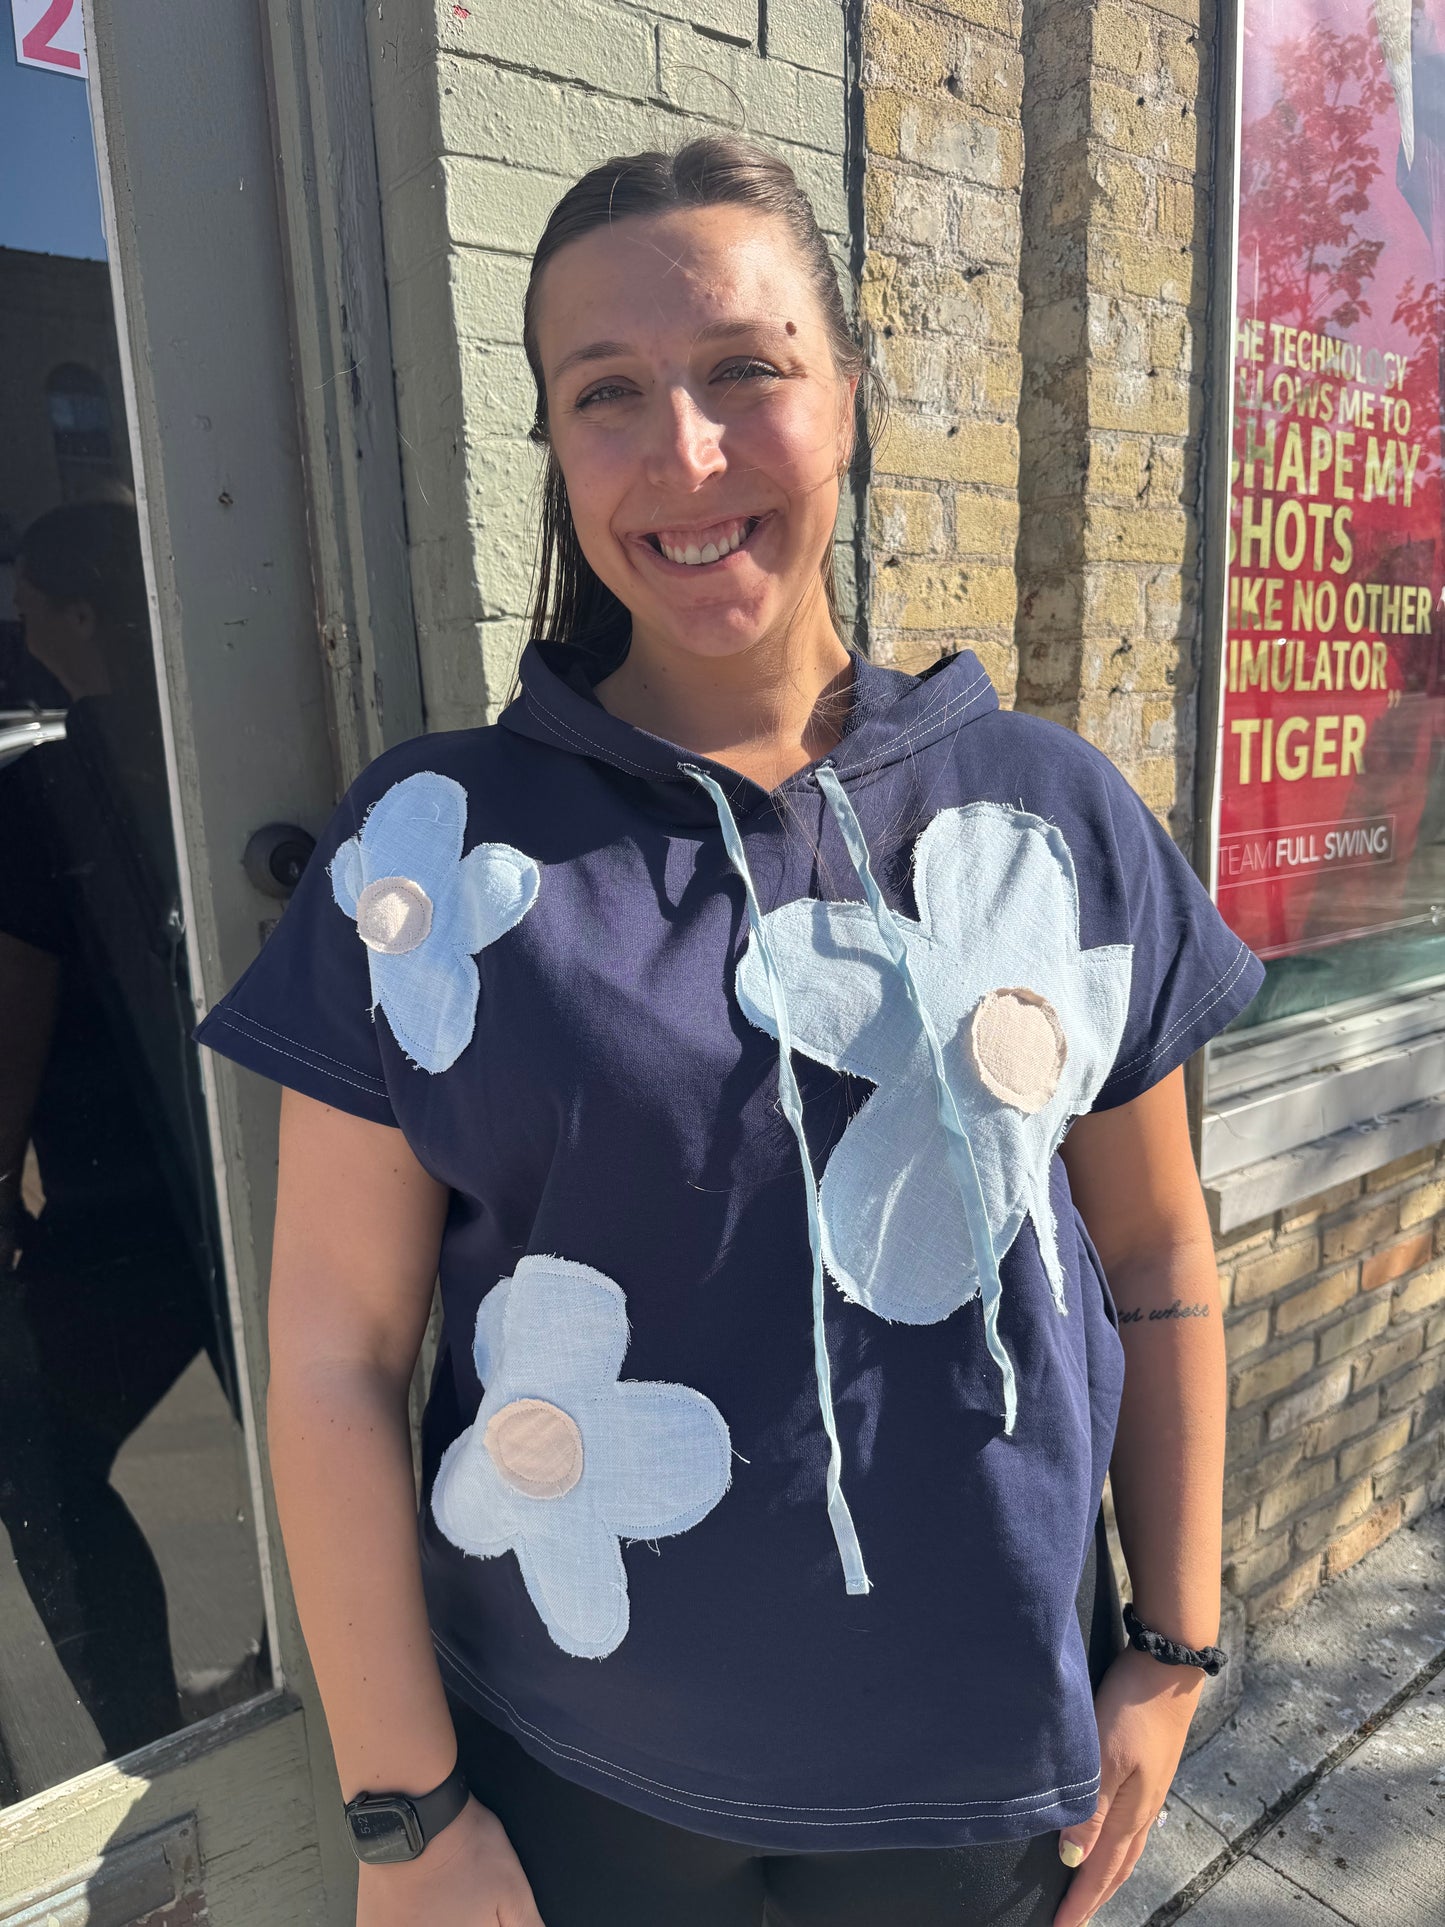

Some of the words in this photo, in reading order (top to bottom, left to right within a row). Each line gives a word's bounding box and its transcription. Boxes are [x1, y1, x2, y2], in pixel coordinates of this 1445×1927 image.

[22, 0, 81, 70] 2
[1269, 322, 1408, 392] TECHNOLOGY
[1337, 386, 1375, 430] ME
[1380, 395, 1412, 436] TO
[1363, 436, 1421, 508] MY
[1291, 579, 1338, 633] NO
[1344, 582, 1432, 635] OTHER
[1231, 714, 1367, 785] TIGER
[1218, 840, 1272, 877] TEAM
[1275, 834, 1320, 868] FULL
[1323, 825, 1389, 861] SWING
